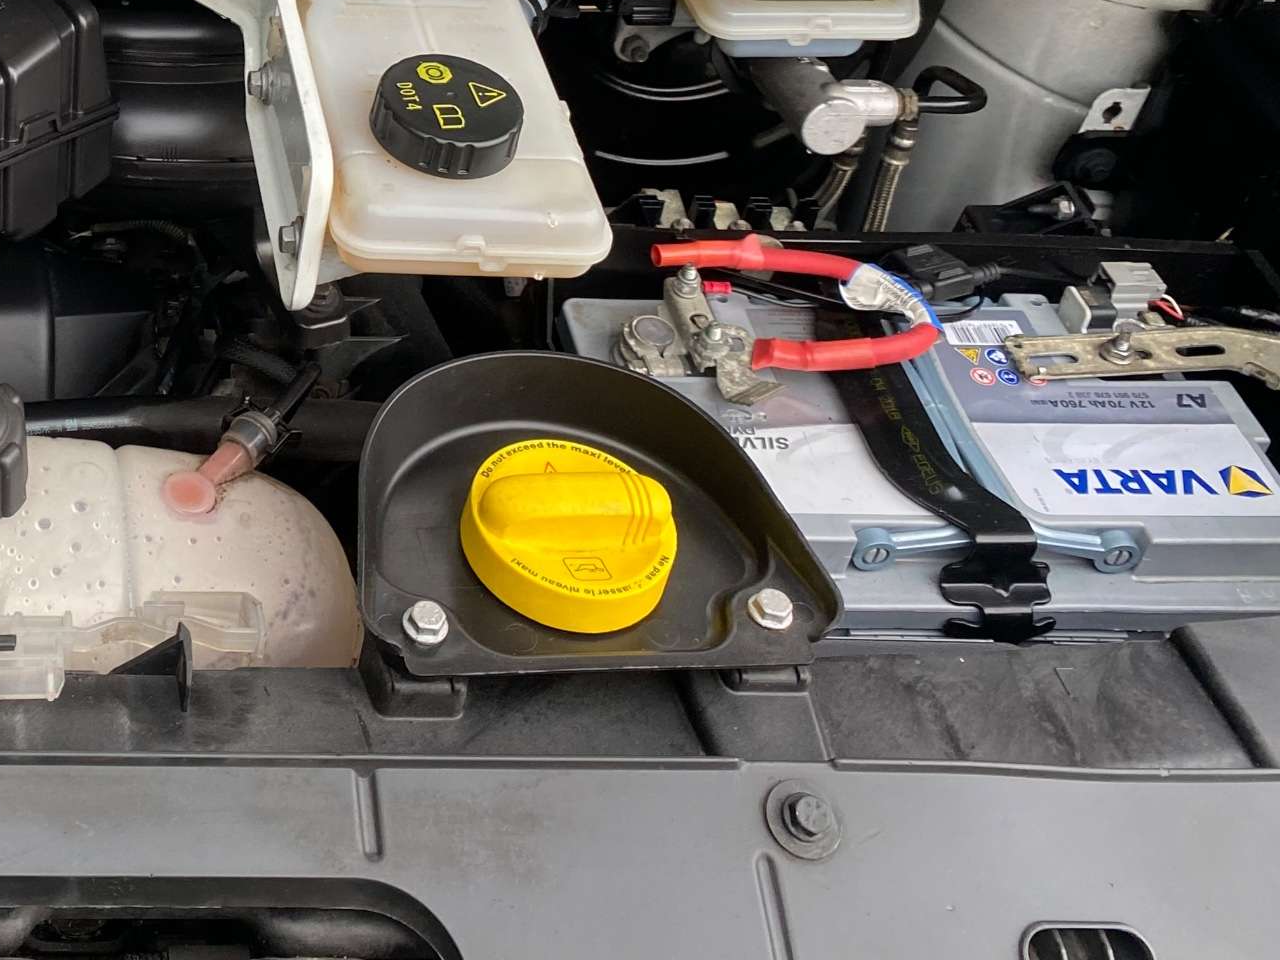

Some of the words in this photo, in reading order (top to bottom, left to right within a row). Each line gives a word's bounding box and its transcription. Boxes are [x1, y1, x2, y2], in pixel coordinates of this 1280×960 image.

[1088, 400, 1125, 409] 70Ah
[1130, 400, 1155, 409] 12V
[1176, 393, 1207, 408] A7
[480, 466, 493, 479] Do
[491, 453, 506, 467] not
[506, 442, 544, 458] exceed
[546, 442, 567, 450] the
[570, 445, 601, 460] maxi
[1052, 469, 1220, 495] VARTA
